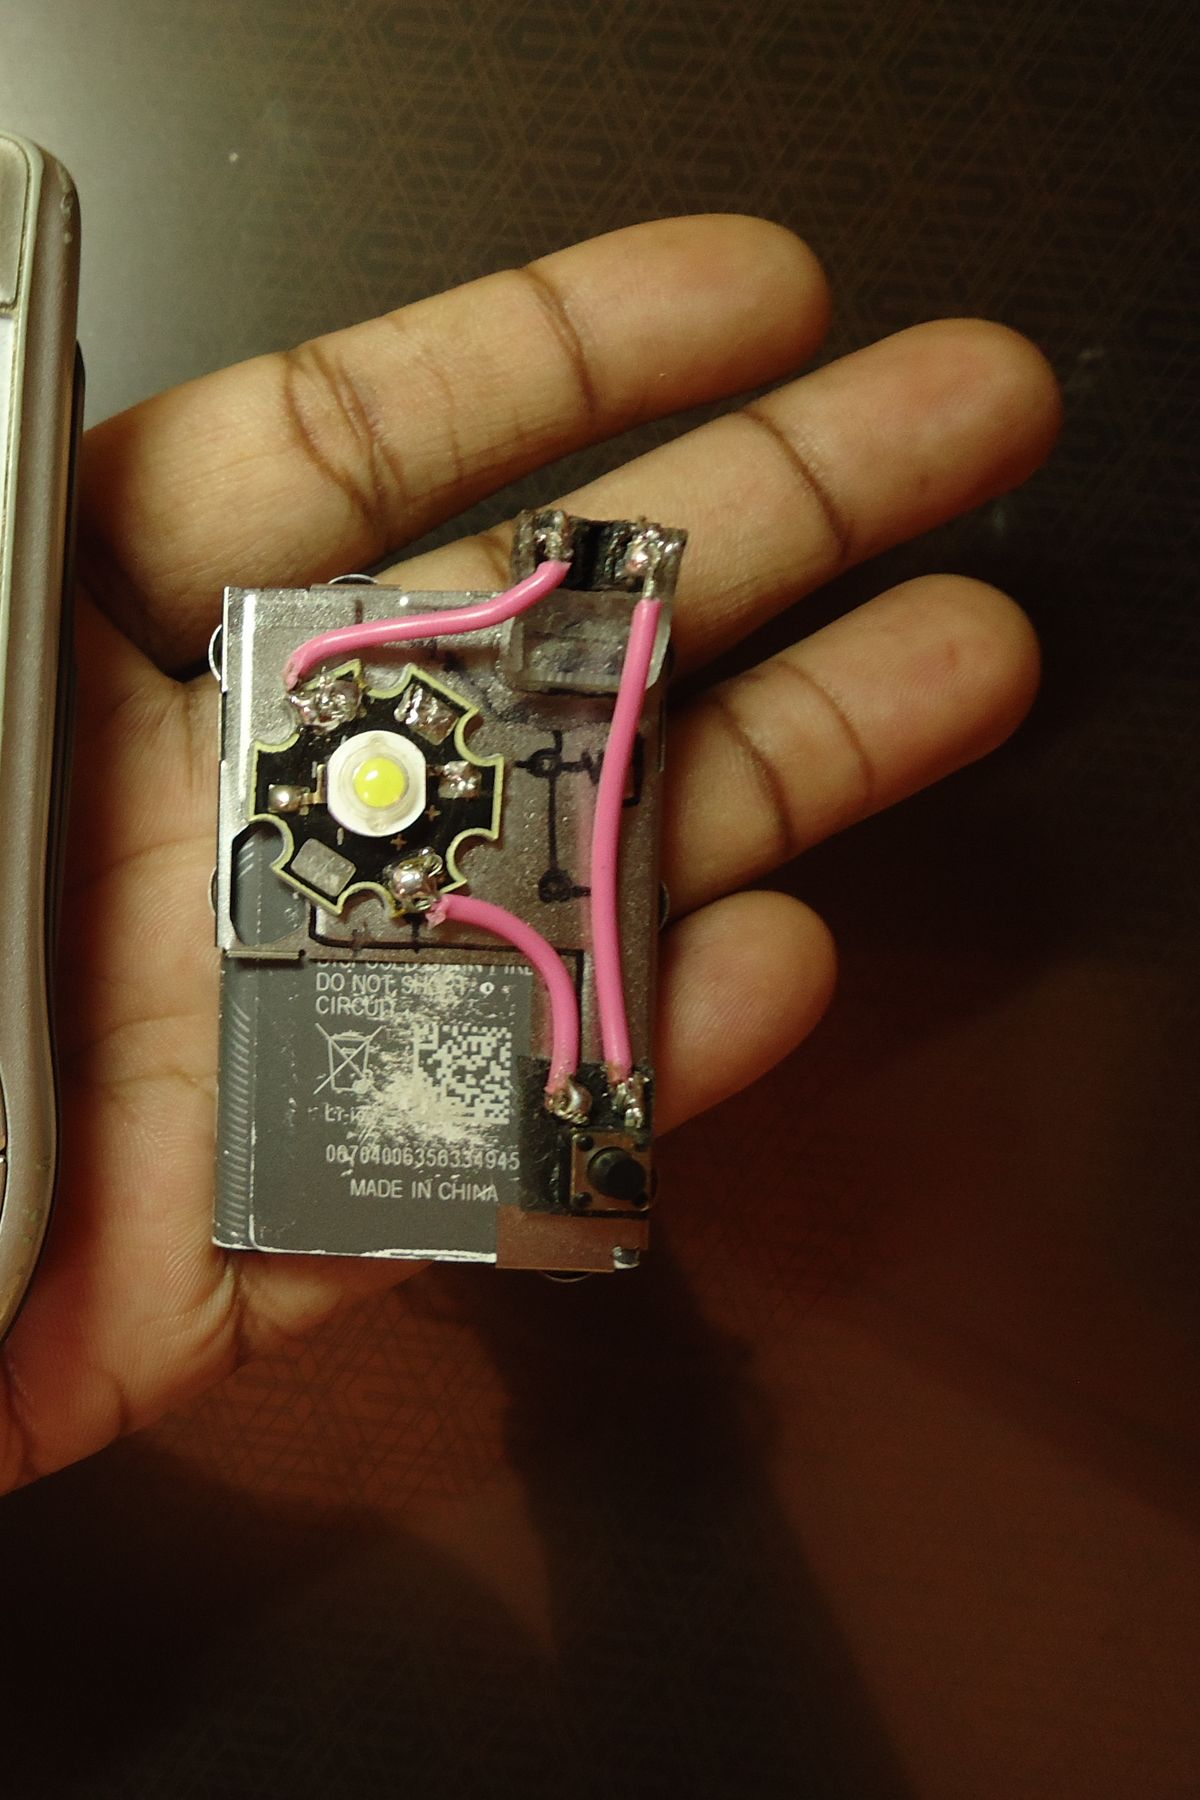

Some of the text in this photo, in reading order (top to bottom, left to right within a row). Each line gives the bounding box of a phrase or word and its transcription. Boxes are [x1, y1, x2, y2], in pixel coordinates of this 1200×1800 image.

[315, 972, 467, 995] DO NOT SHT
[350, 1178, 499, 1201] MADE IN CHINA
